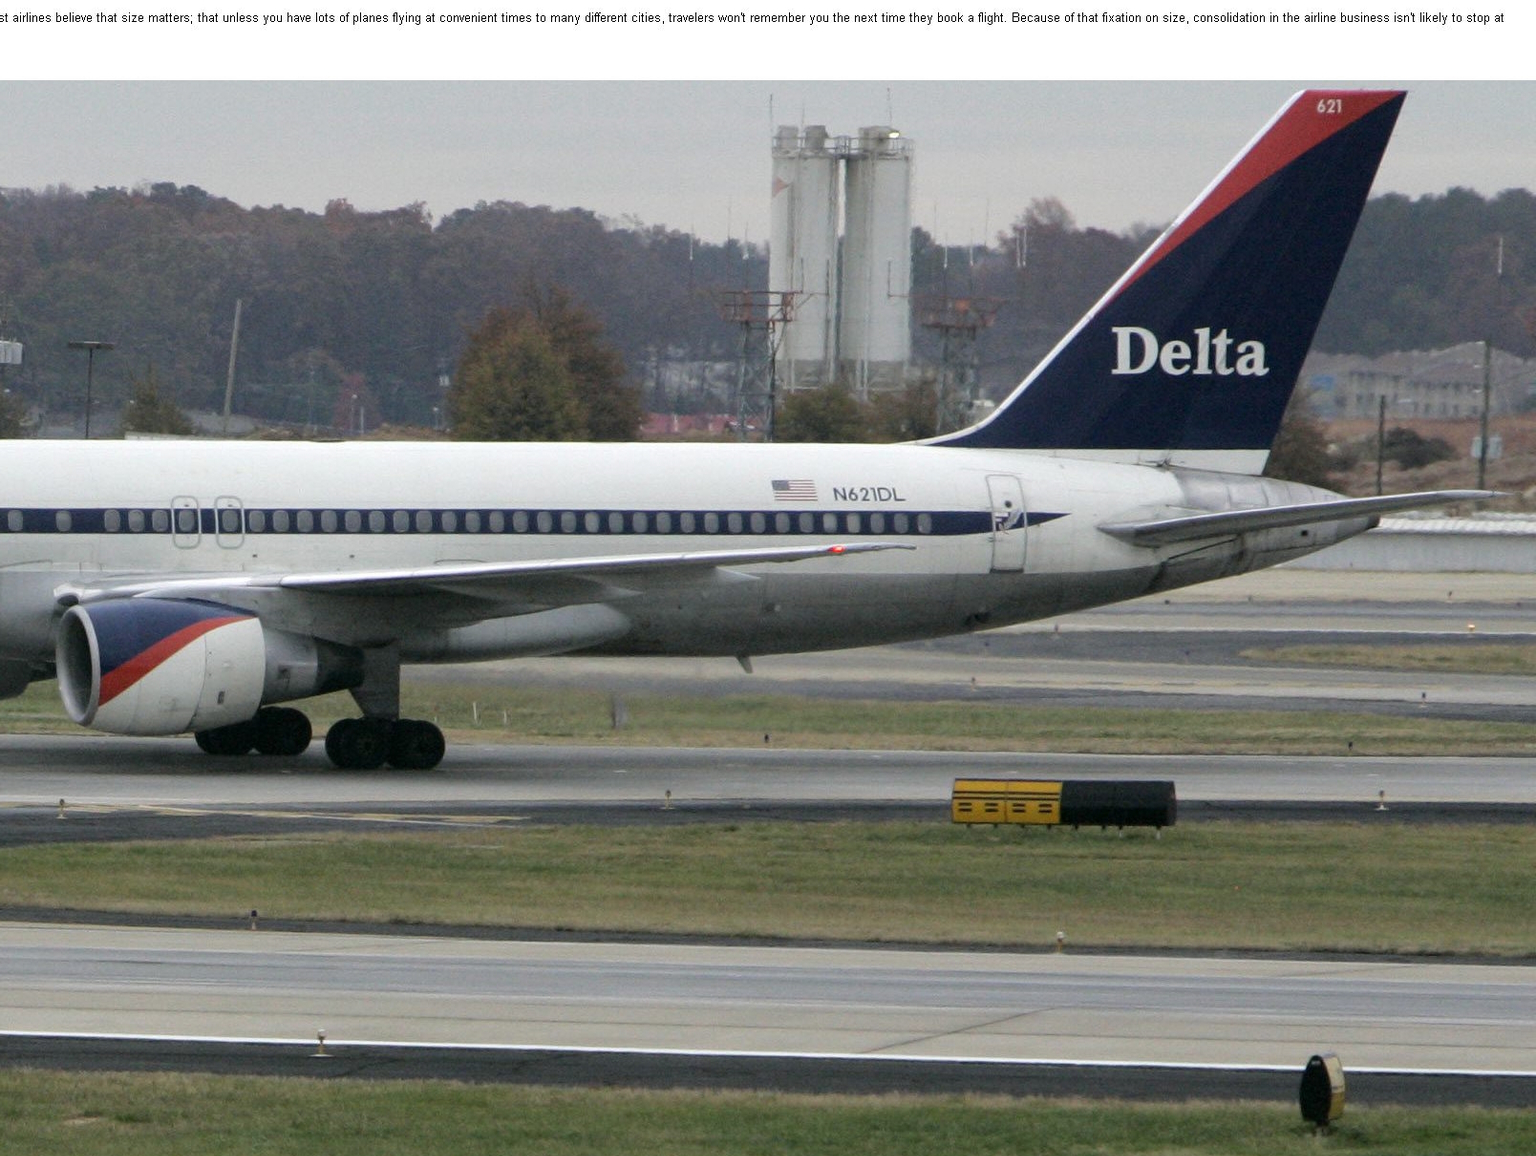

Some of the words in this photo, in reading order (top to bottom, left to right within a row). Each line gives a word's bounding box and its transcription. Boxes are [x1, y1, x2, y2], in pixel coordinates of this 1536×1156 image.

[1316, 99, 1342, 113] 621
[1111, 326, 1270, 376] Delta
[832, 486, 907, 502] N621DL
